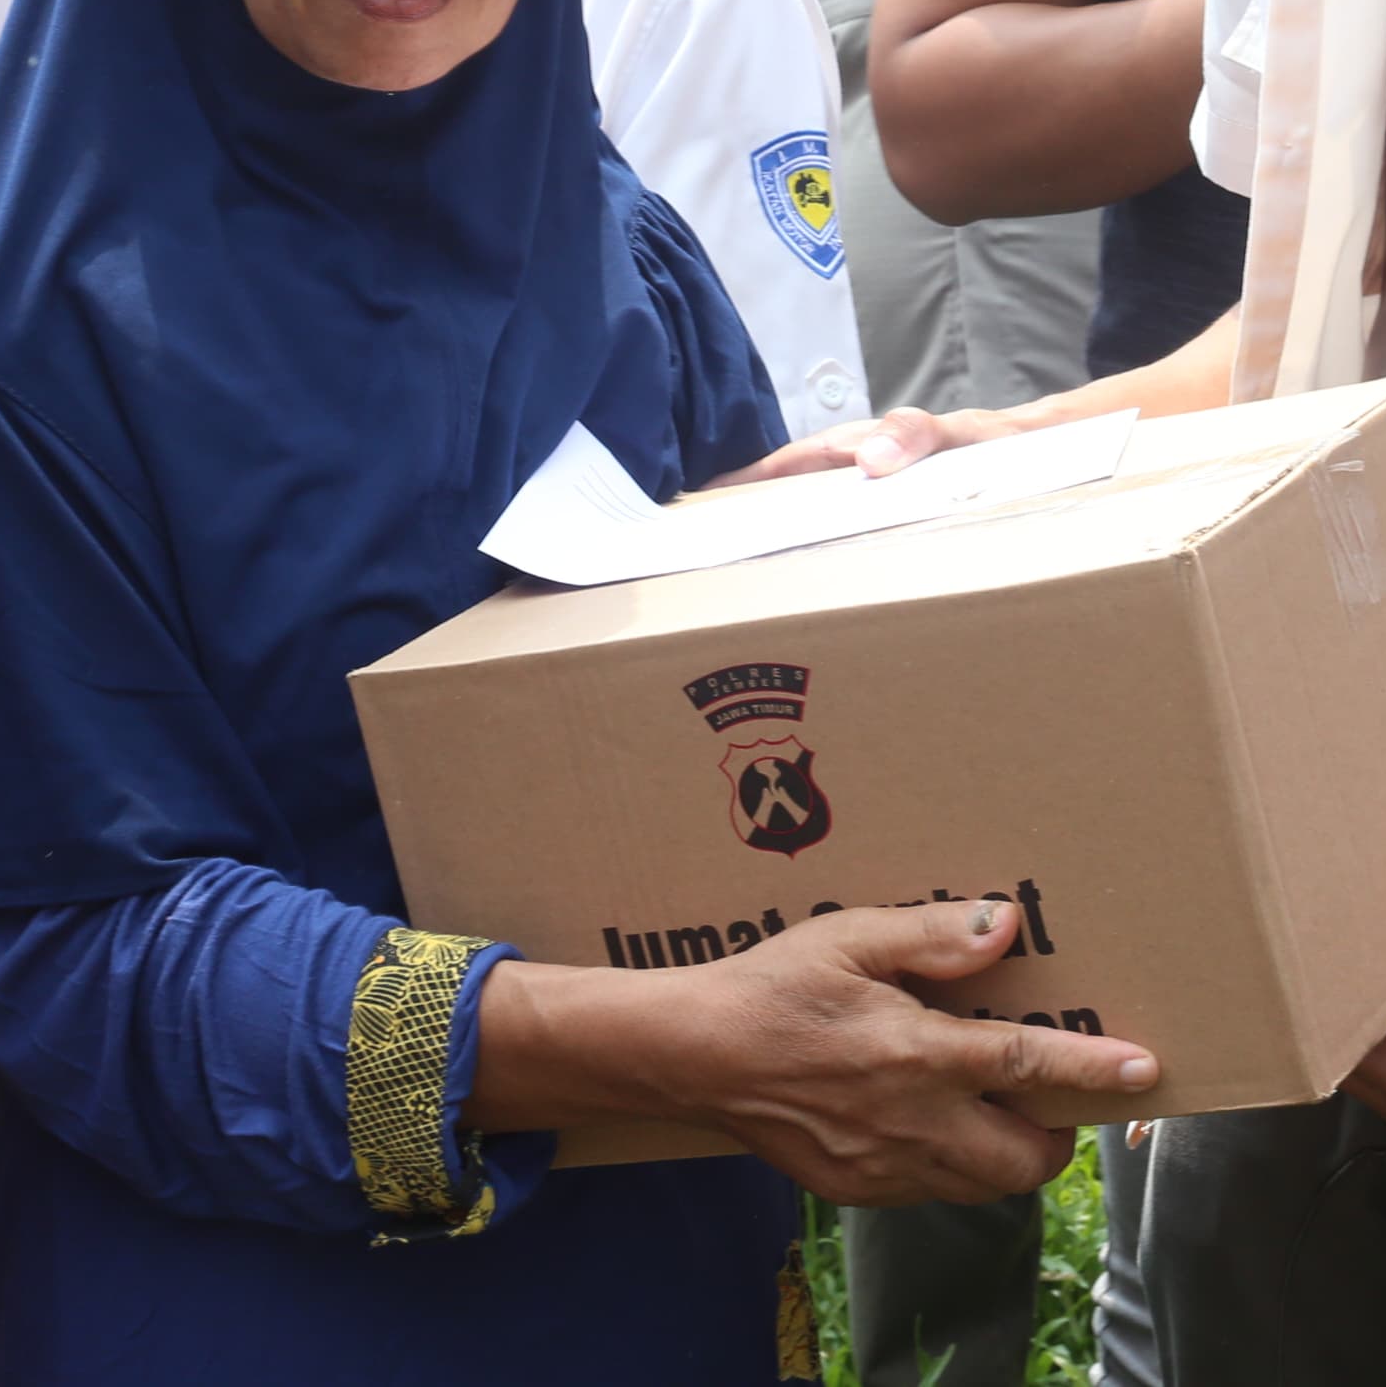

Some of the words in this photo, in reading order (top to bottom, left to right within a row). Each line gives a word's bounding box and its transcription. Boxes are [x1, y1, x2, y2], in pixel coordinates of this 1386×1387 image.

[687, 667, 805, 697] POLRES
[712, 678, 783, 698] JEMBER
[715, 706, 750, 726] JAWA
[751, 703, 796, 716] TIMUR
